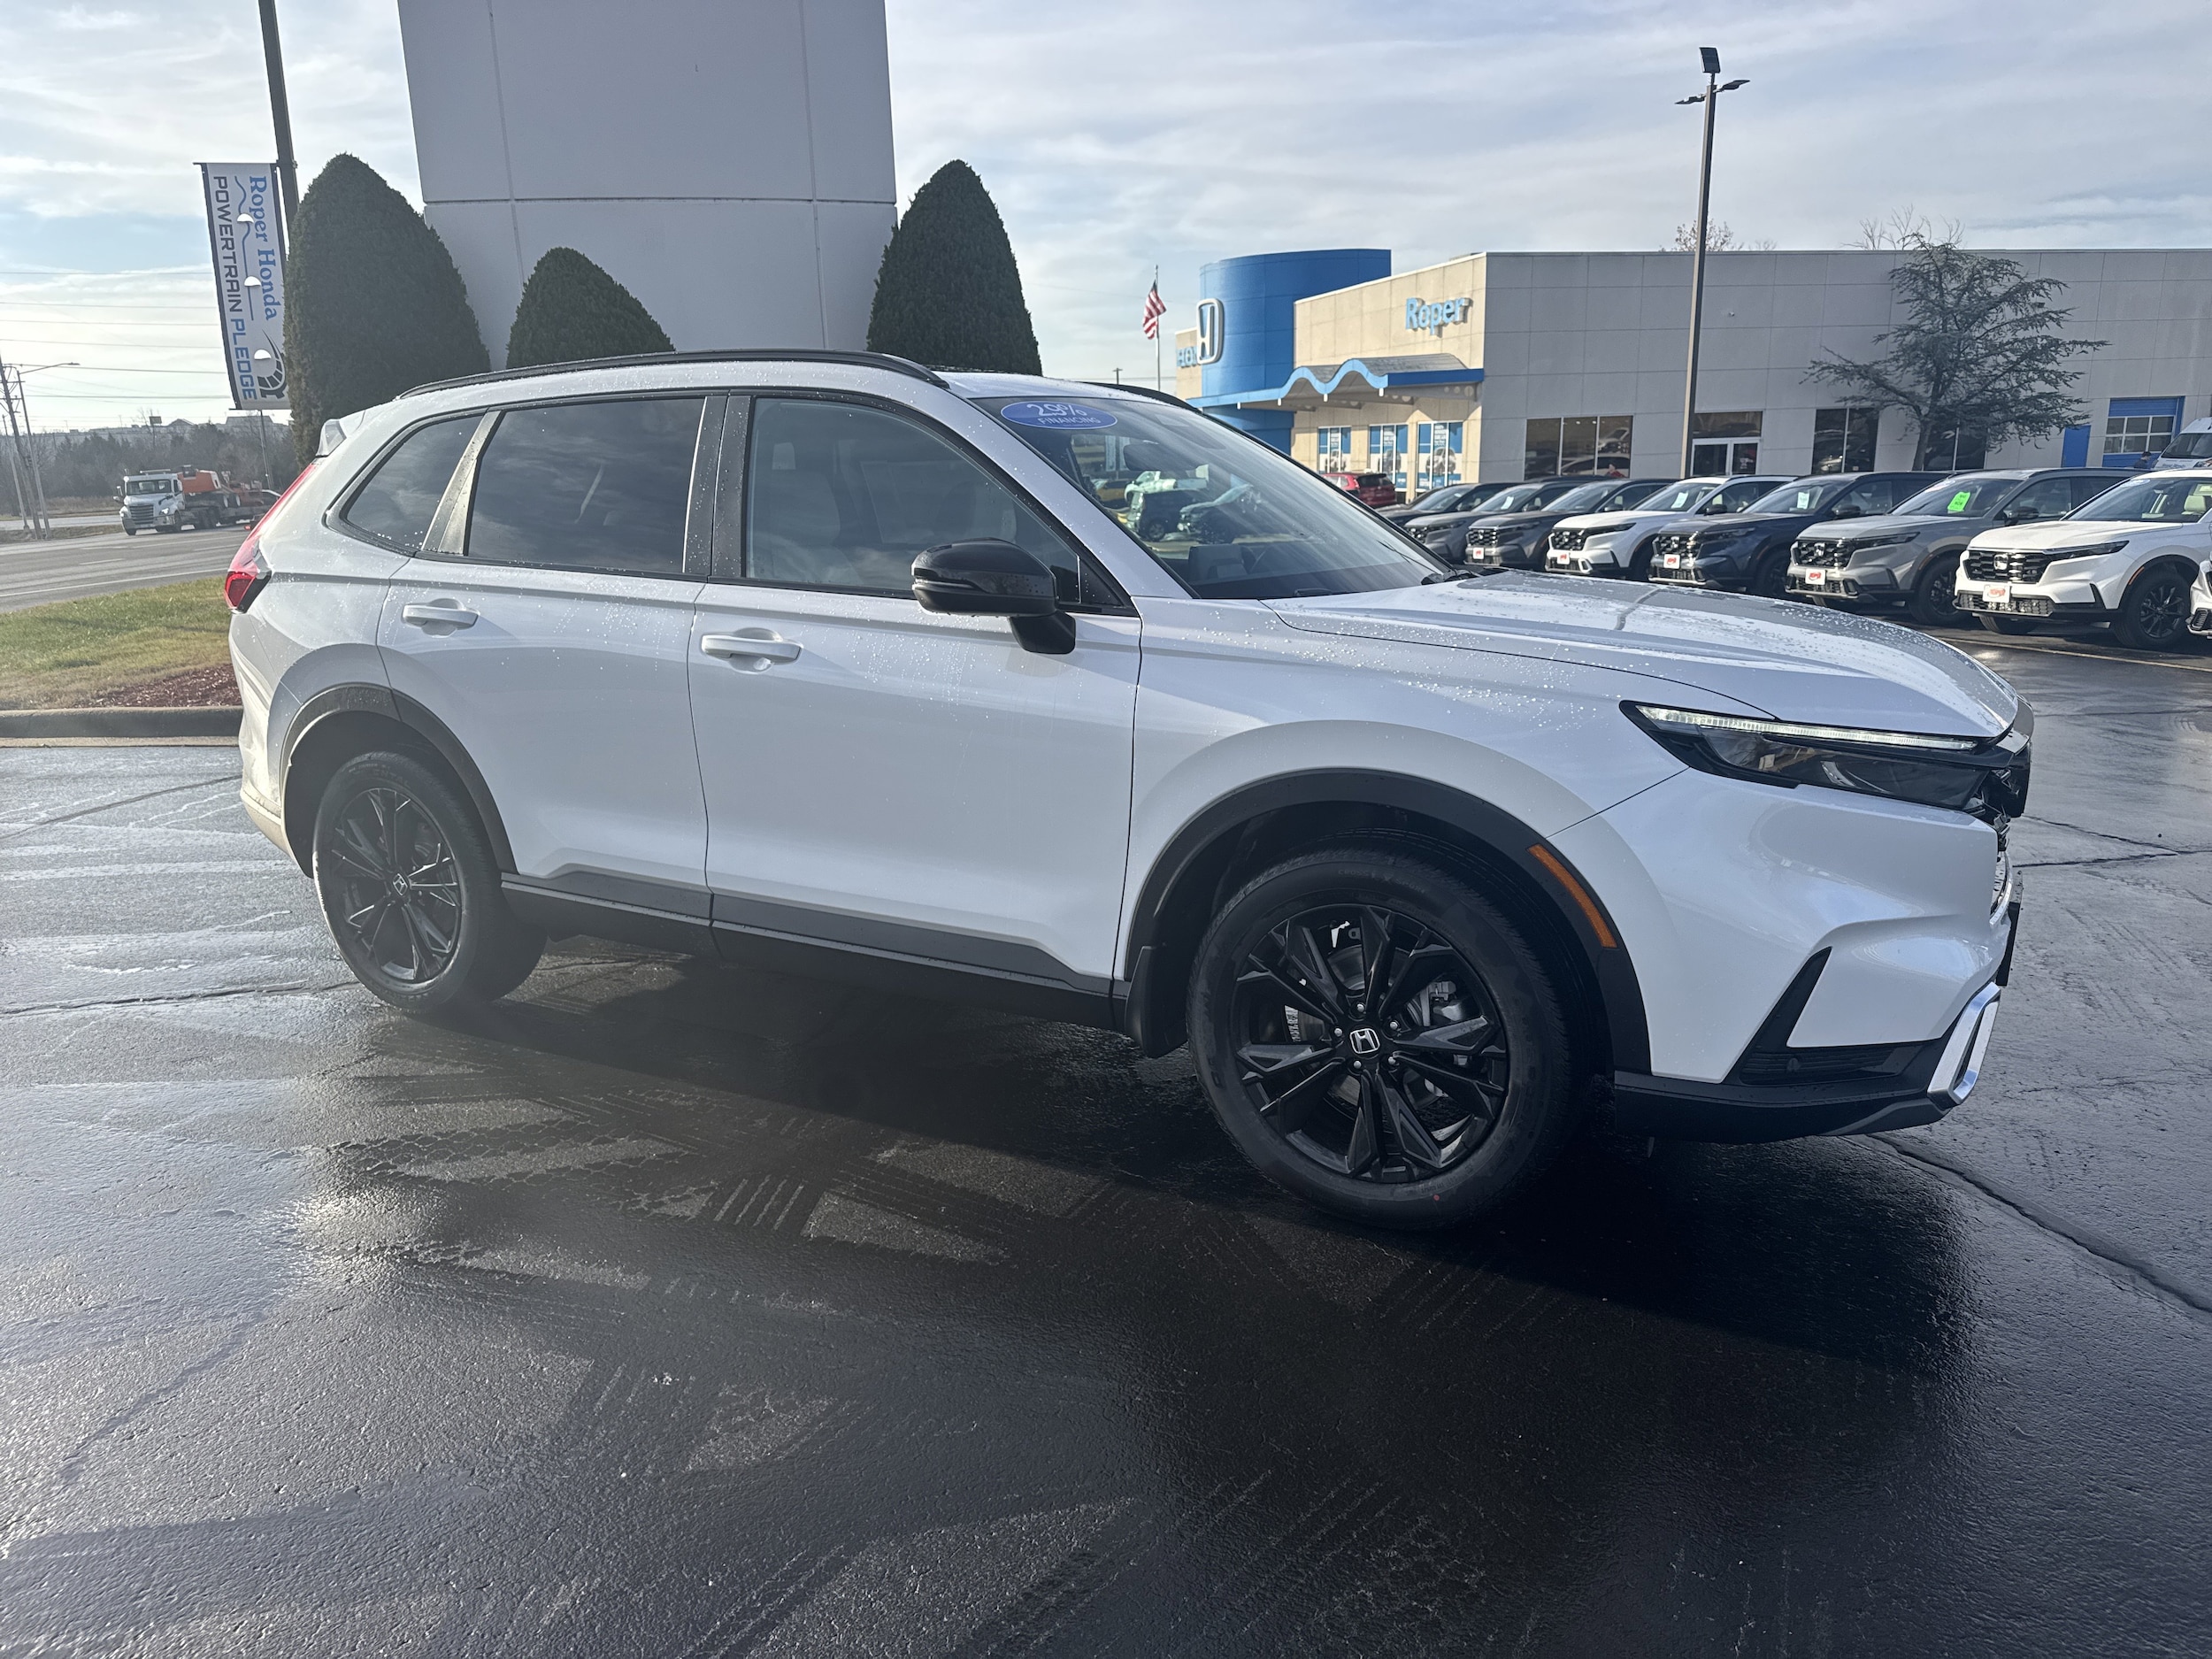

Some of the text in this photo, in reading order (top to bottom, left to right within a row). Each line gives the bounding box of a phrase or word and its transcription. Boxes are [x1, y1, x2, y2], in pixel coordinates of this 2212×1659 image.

[212, 175, 257, 401] POWERTRAIN PLEDGE
[249, 175, 281, 320] Roper Honda
[1405, 297, 1471, 335] Roper
